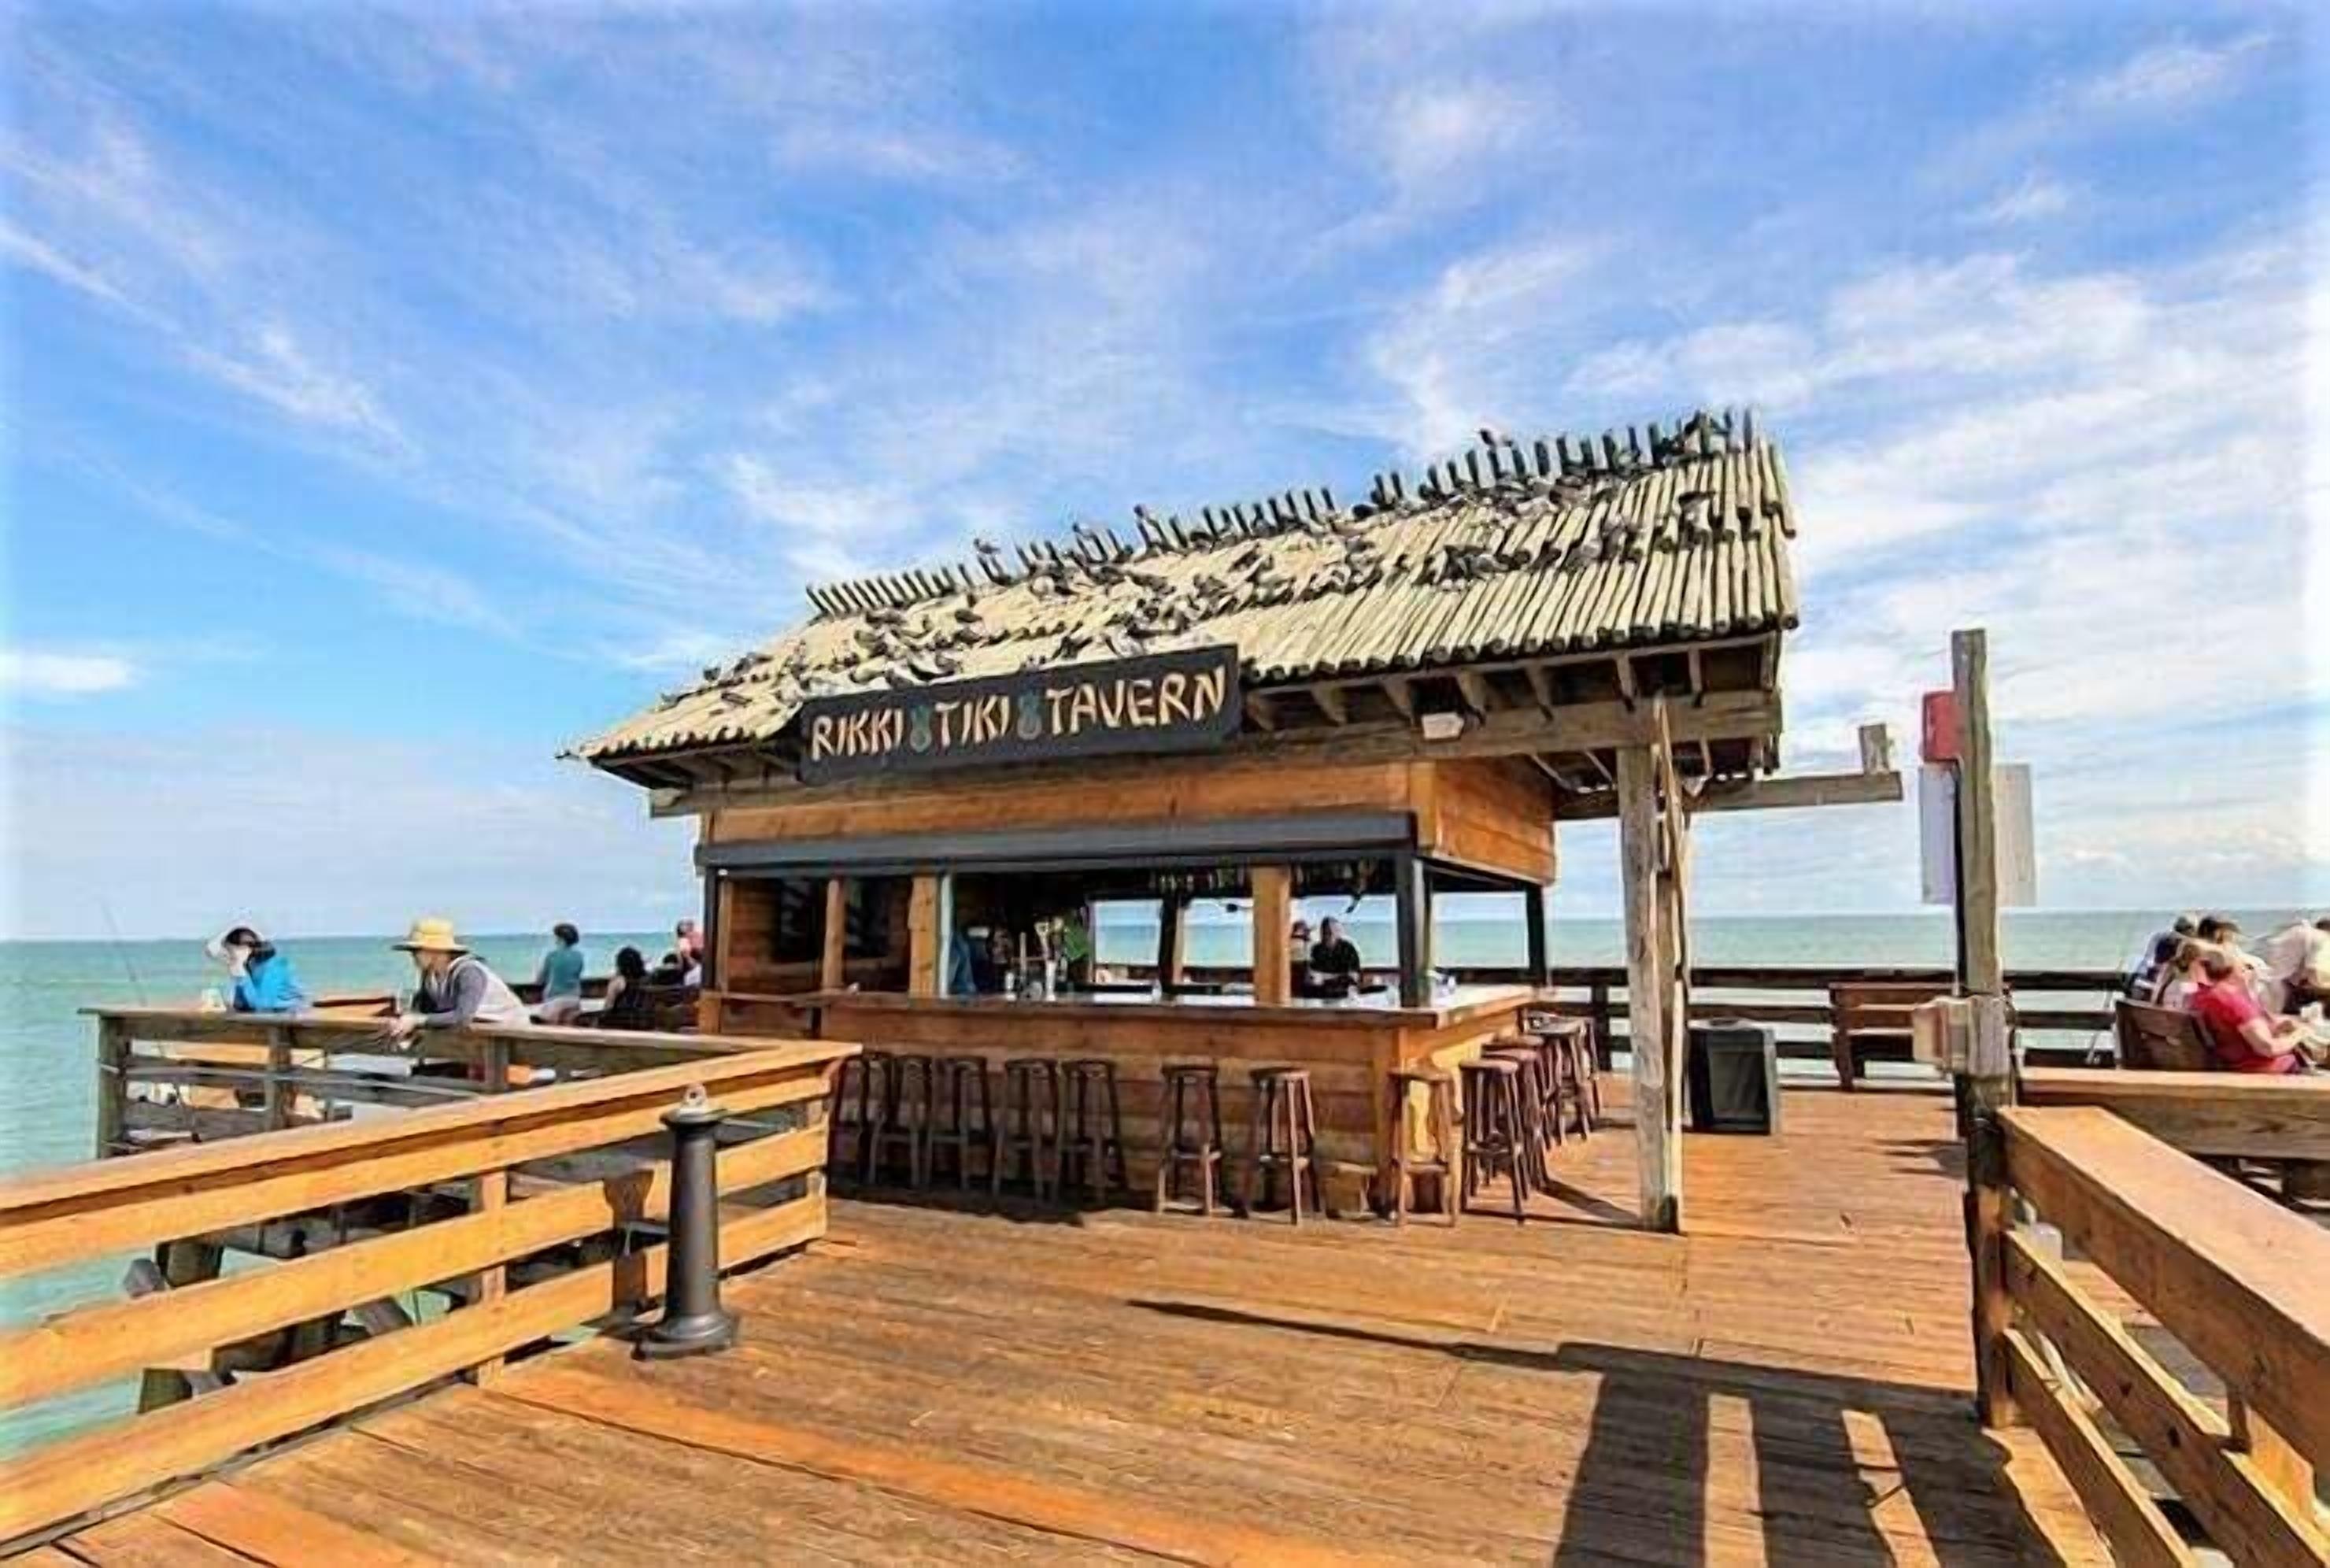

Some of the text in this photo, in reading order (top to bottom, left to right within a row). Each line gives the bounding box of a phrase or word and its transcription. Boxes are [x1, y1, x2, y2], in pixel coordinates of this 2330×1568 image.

[812, 666, 1226, 761] RIKKI TIKI TAVERN
